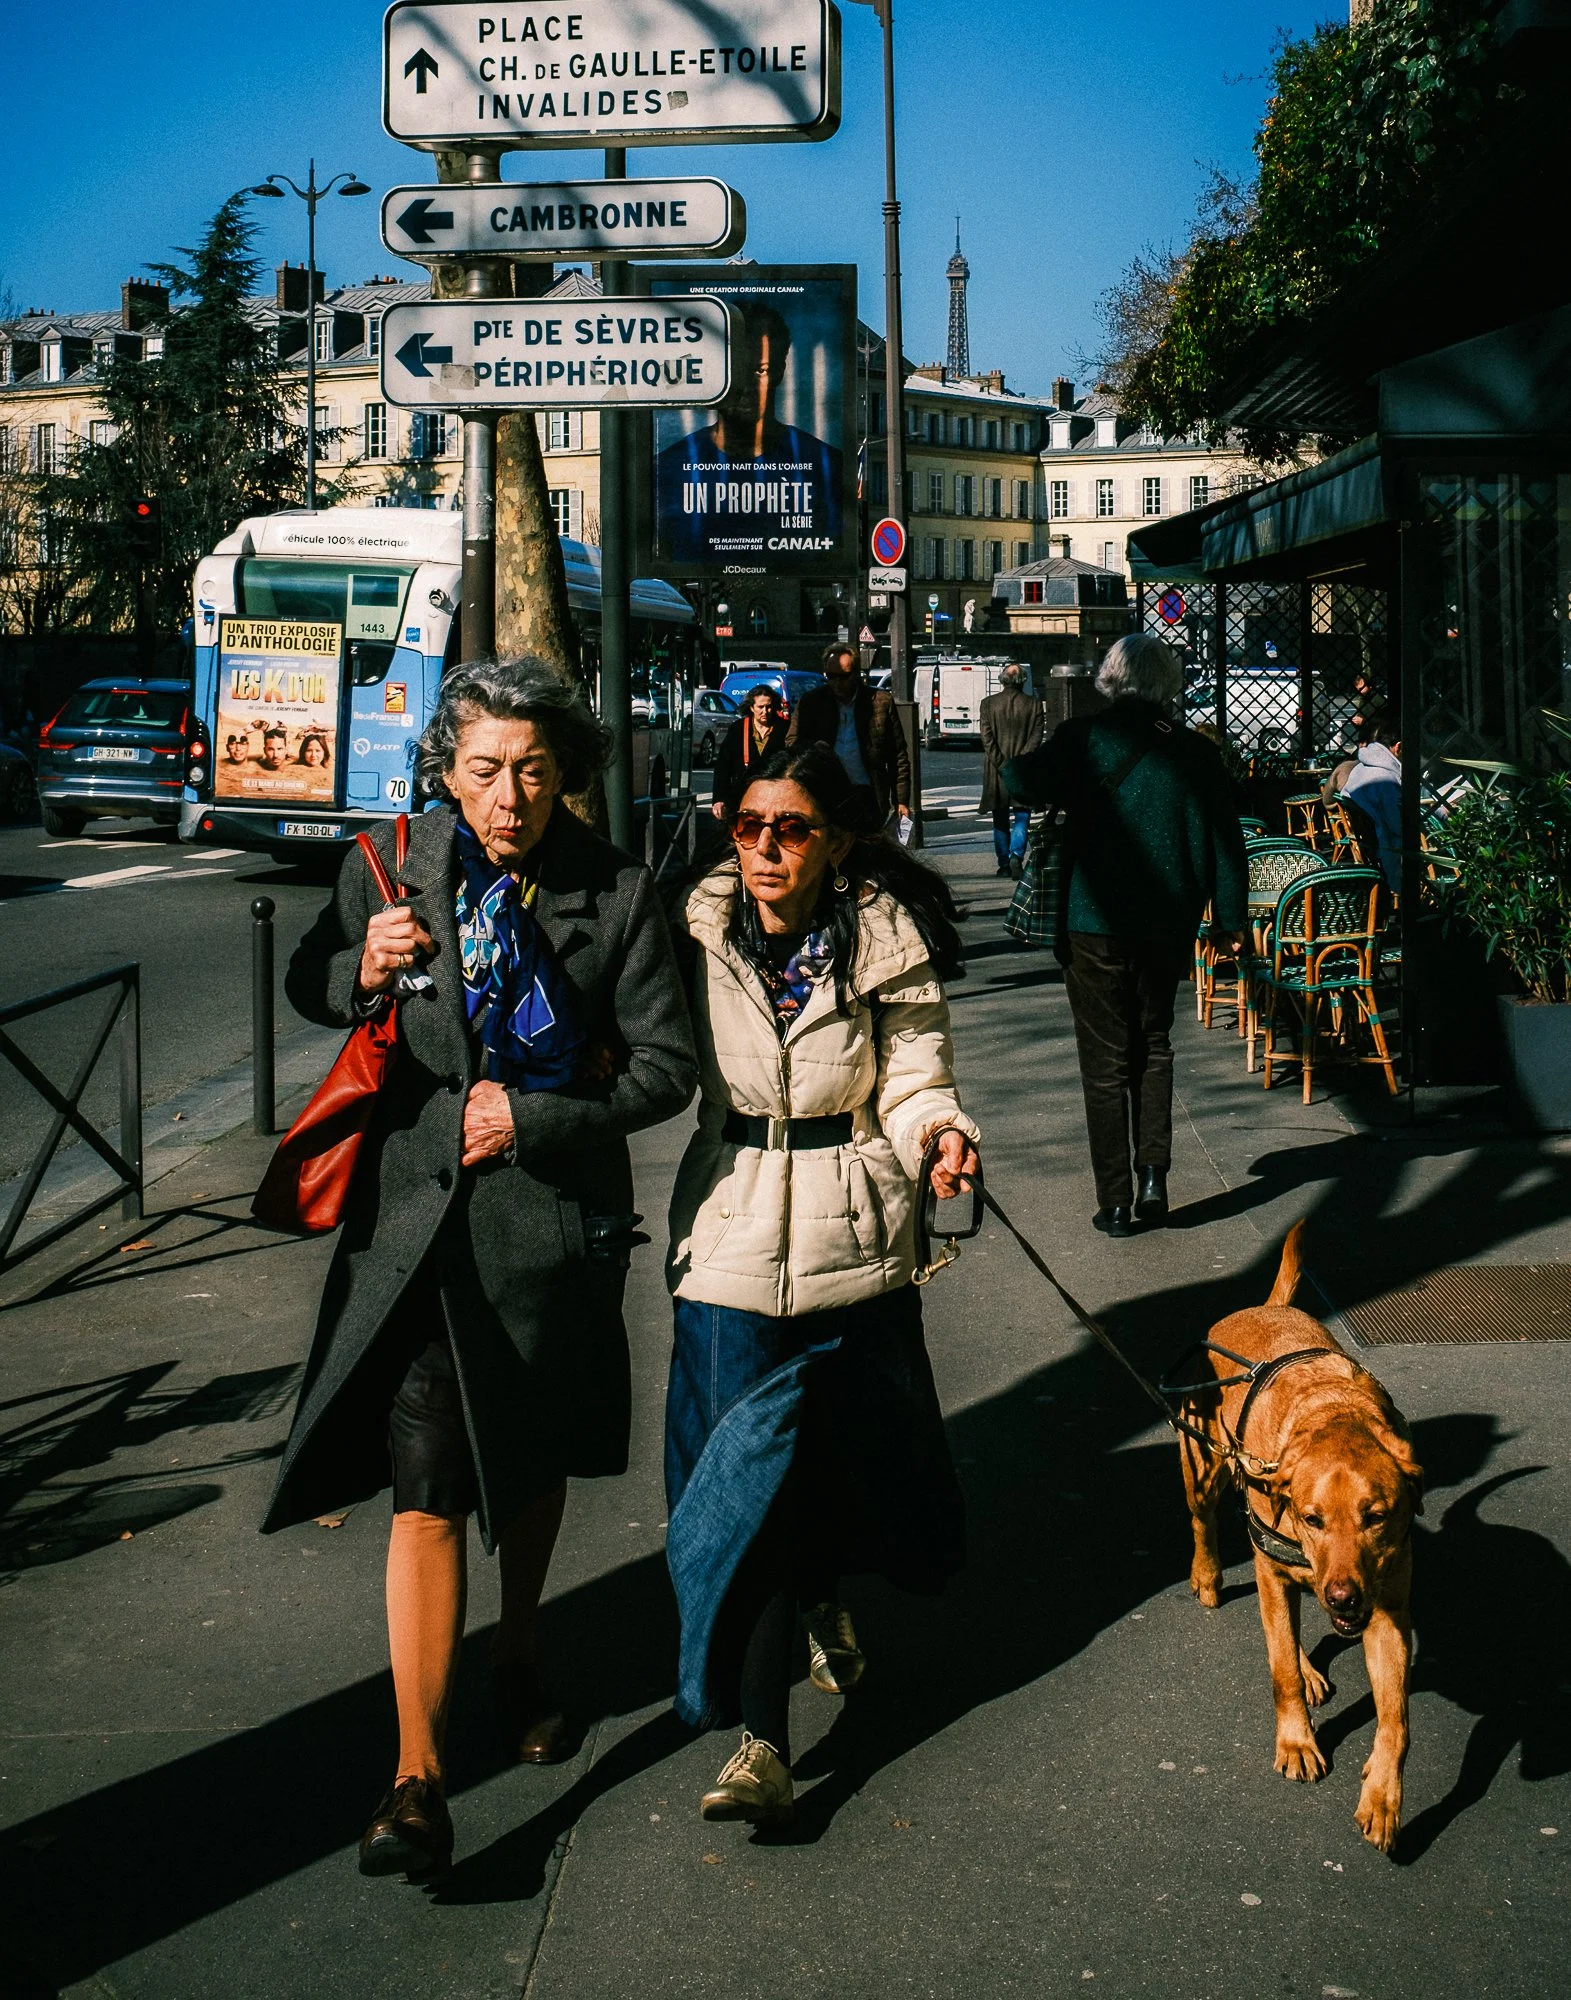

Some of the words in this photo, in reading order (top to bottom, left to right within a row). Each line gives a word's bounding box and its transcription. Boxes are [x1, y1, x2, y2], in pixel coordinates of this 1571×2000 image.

[478, 14, 584, 43] PLACE
[479, 55, 527, 82] CH.
[535, 63, 561, 80] DE
[569, 45, 807, 79] GAULLE-ETOILE
[478, 88, 663, 120] INVALIDES
[490, 201, 687, 233] CAMBRONNE
[525, 319, 562, 346] DE
[575, 313, 703, 345] SÈVRES
[474, 354, 703, 387] PÉRIPHÉRIQUE
[682, 463, 692, 471] LE
[693, 463, 731, 471] POUVOIR
[753, 463, 777, 471] DANS
[778, 463, 813, 471] L'OMBRE
[683, 482, 708, 514] UN
[715, 477, 813, 514] PROPHÈTE
[781, 516, 790, 528] LA
[792, 514, 813, 528] SÉRIE
[282, 534, 325, 544] véhicule
[328, 535, 356, 545] 100%
[358, 536, 410, 548] électrique
[767, 537, 834, 550] CANAL+
[722, 565, 767, 574] JCDecaux
[250, 624, 277, 636] TRIO
[280, 625, 337, 638] EXPLOSIF
[360, 624, 385, 633] 1443
[226, 635, 336, 652] D'ANTHOLOGIE
[231, 669, 261, 701] LES
[264, 668, 285, 703] K
[287, 671, 326, 704] D'OR
[390, 780, 406, 799] 70
